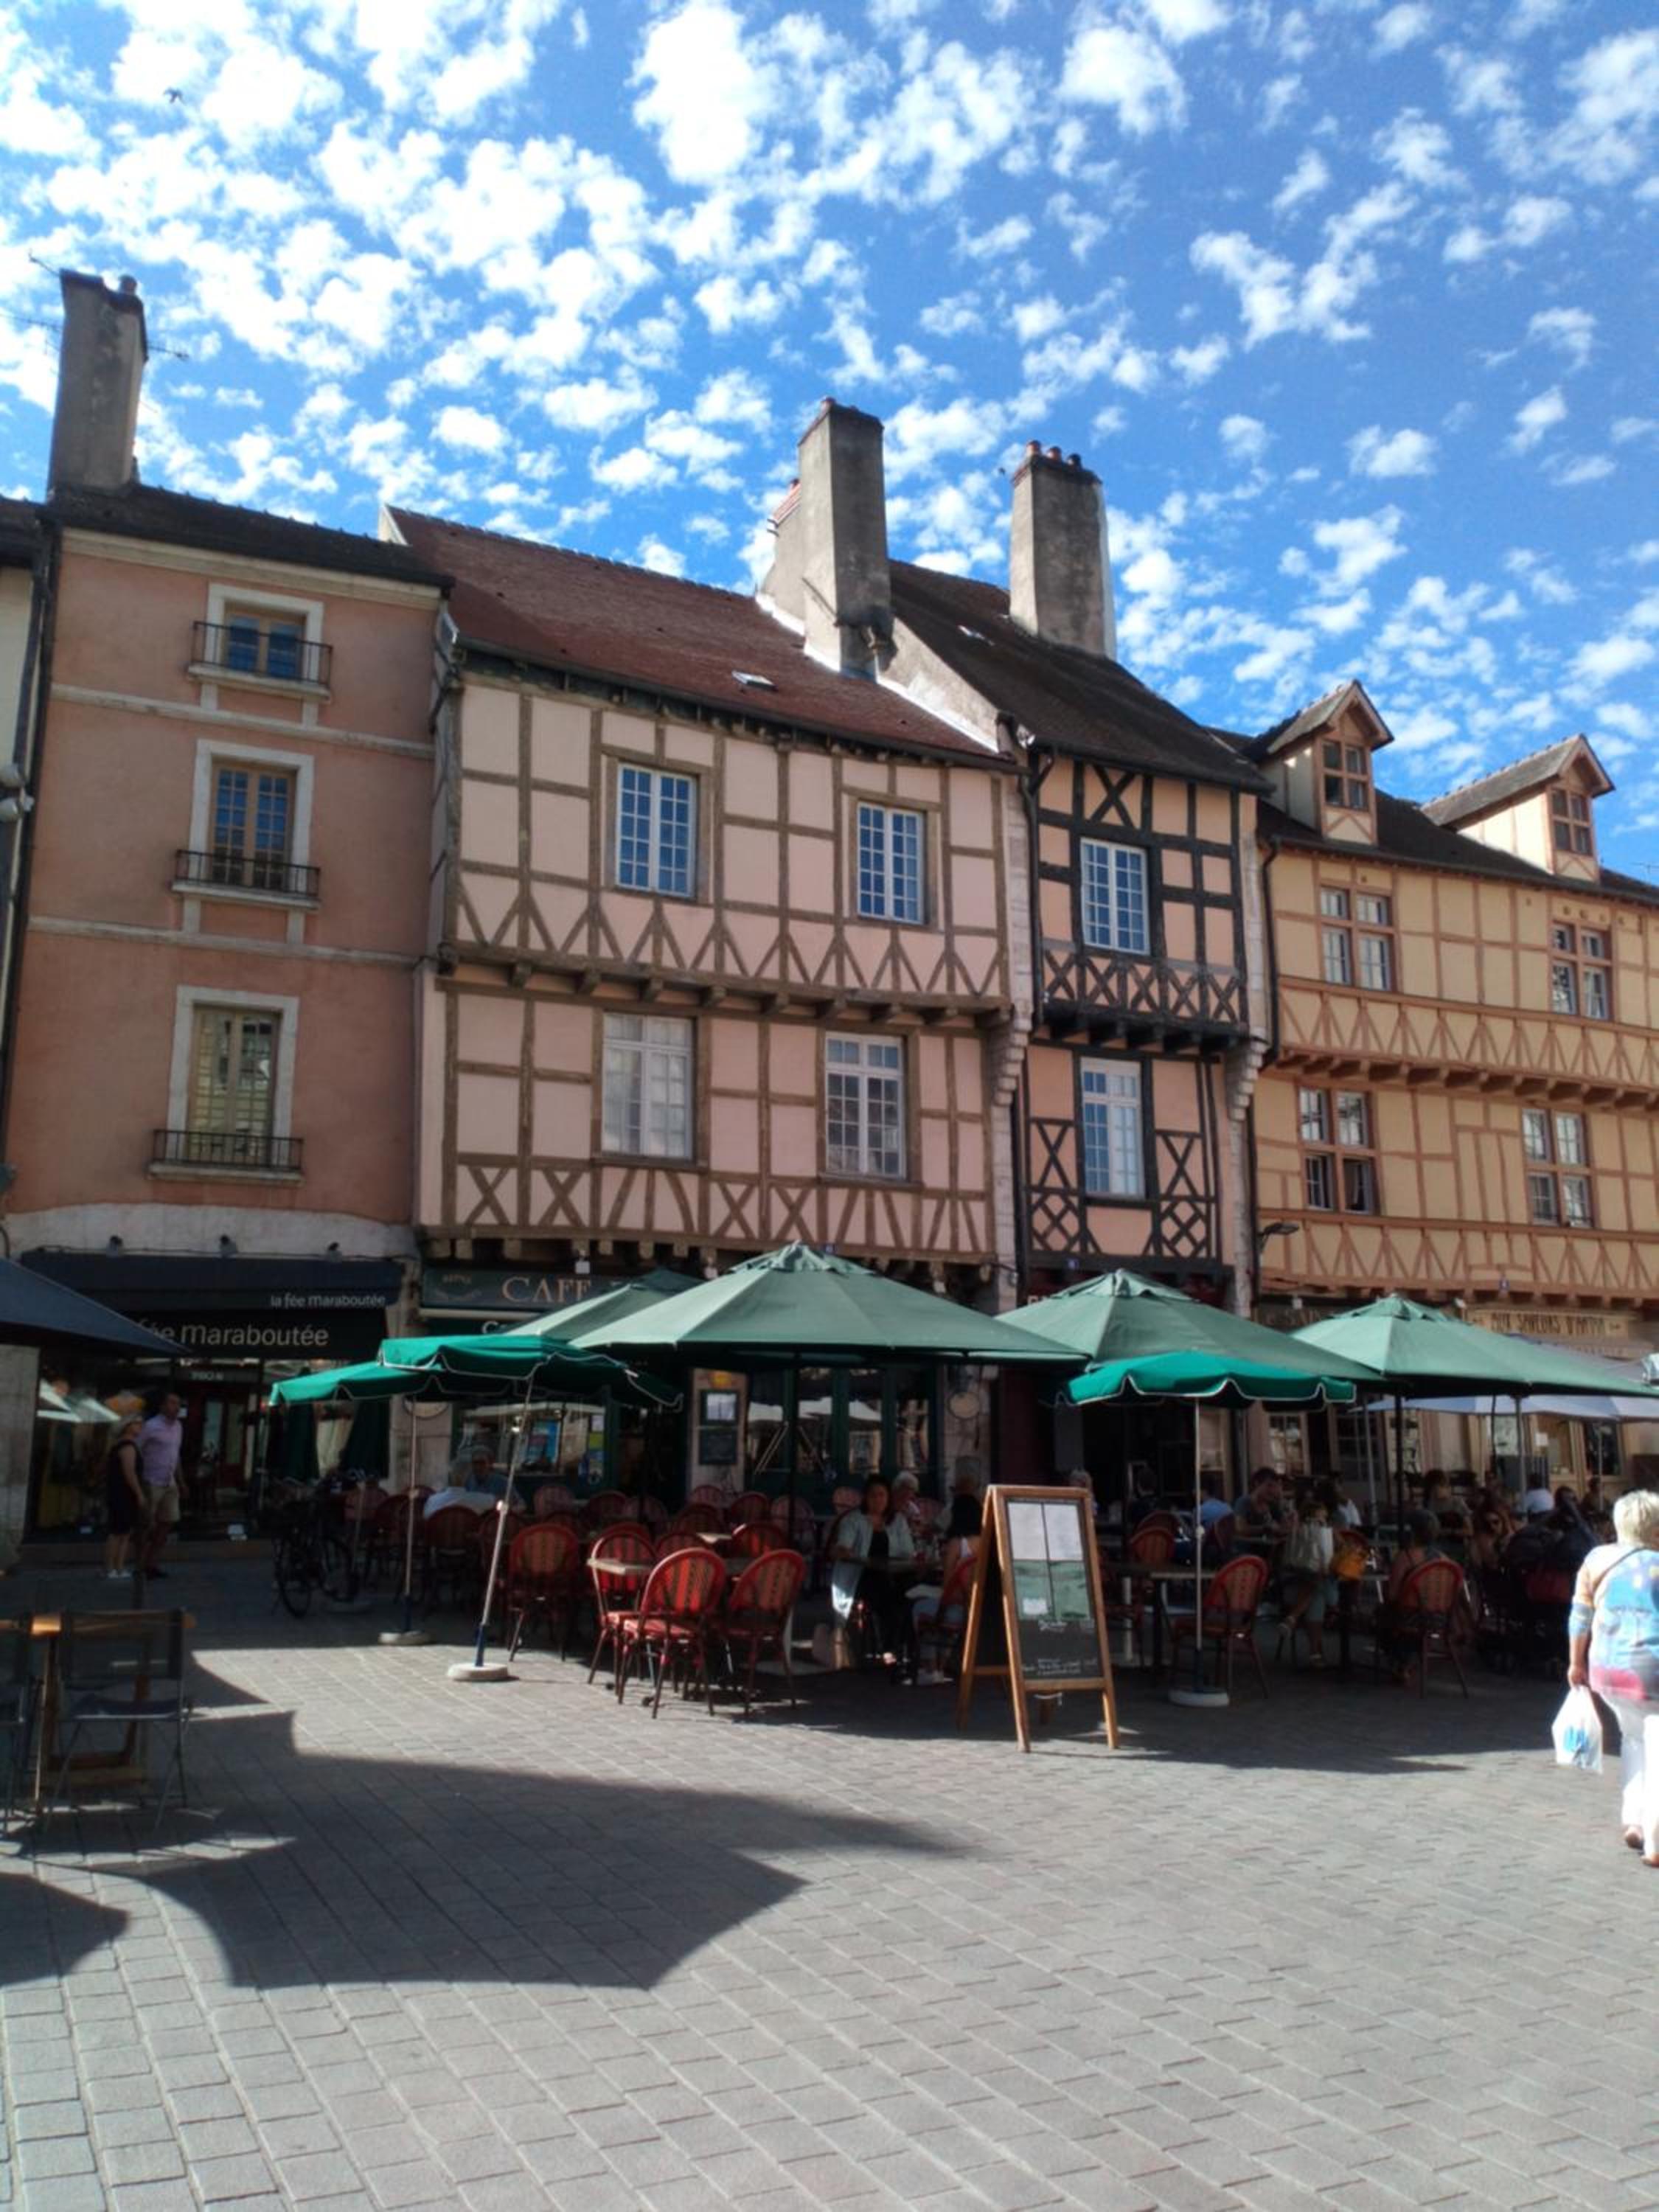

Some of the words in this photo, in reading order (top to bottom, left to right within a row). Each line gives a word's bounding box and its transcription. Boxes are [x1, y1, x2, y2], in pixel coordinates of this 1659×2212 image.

[271, 1295, 282, 1307] la
[285, 1292, 306, 1309] fée
[308, 1293, 386, 1307] maraboutée
[181, 1324, 329, 1346] maraboutée
